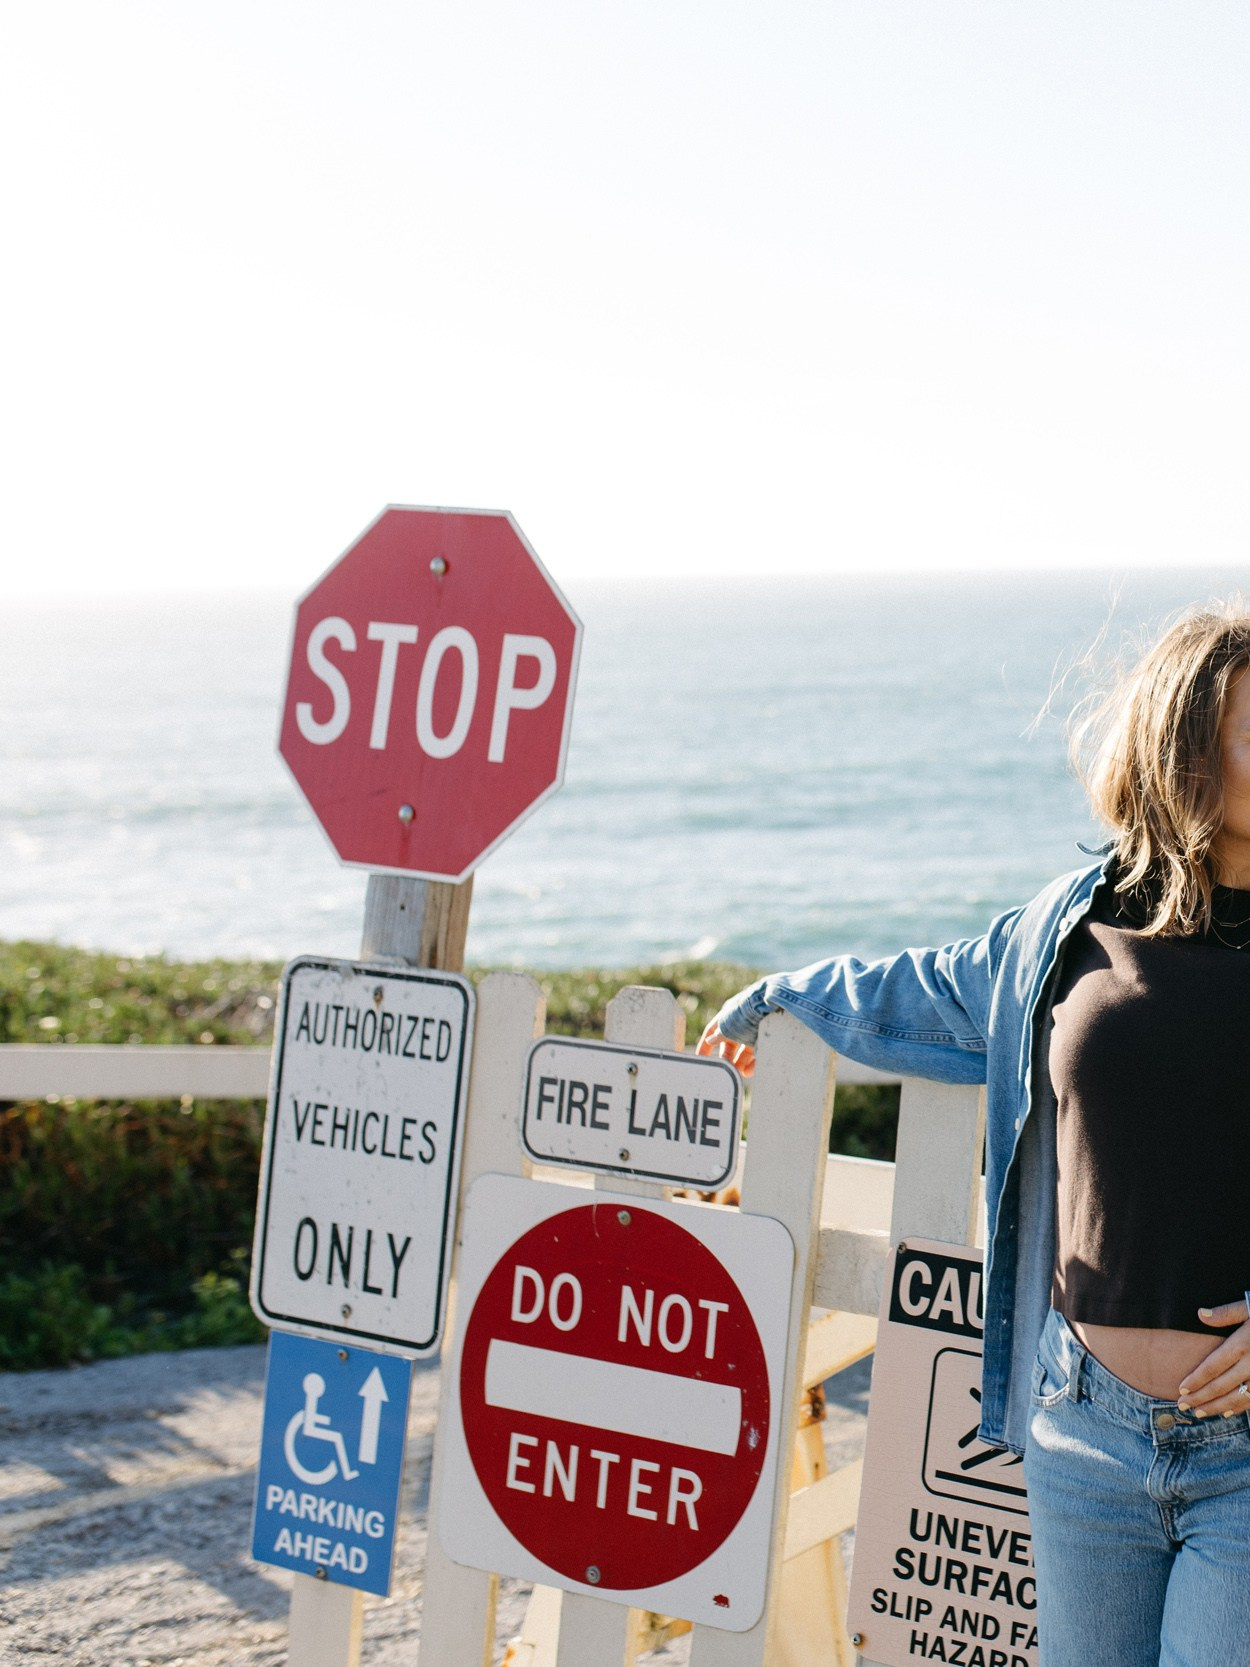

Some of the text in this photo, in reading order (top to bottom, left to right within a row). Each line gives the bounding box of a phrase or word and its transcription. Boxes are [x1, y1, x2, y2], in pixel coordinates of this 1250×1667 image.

[296, 617, 556, 762] STOP
[296, 1001, 451, 1063] AUTHORIZED
[293, 1100, 437, 1165] VEHICLES
[537, 1077, 723, 1148] FIRE LANE
[294, 1216, 412, 1299] ONLY
[511, 1265, 729, 1360] DO NOT
[266, 1485, 385, 1538] PARKING
[506, 1432, 703, 1532] ENTER
[274, 1528, 368, 1574] AHEAD
[909, 1508, 1035, 1568] UNEVE
[870, 1588, 932, 1622] SLIP
[939, 1606, 1001, 1641] AND
